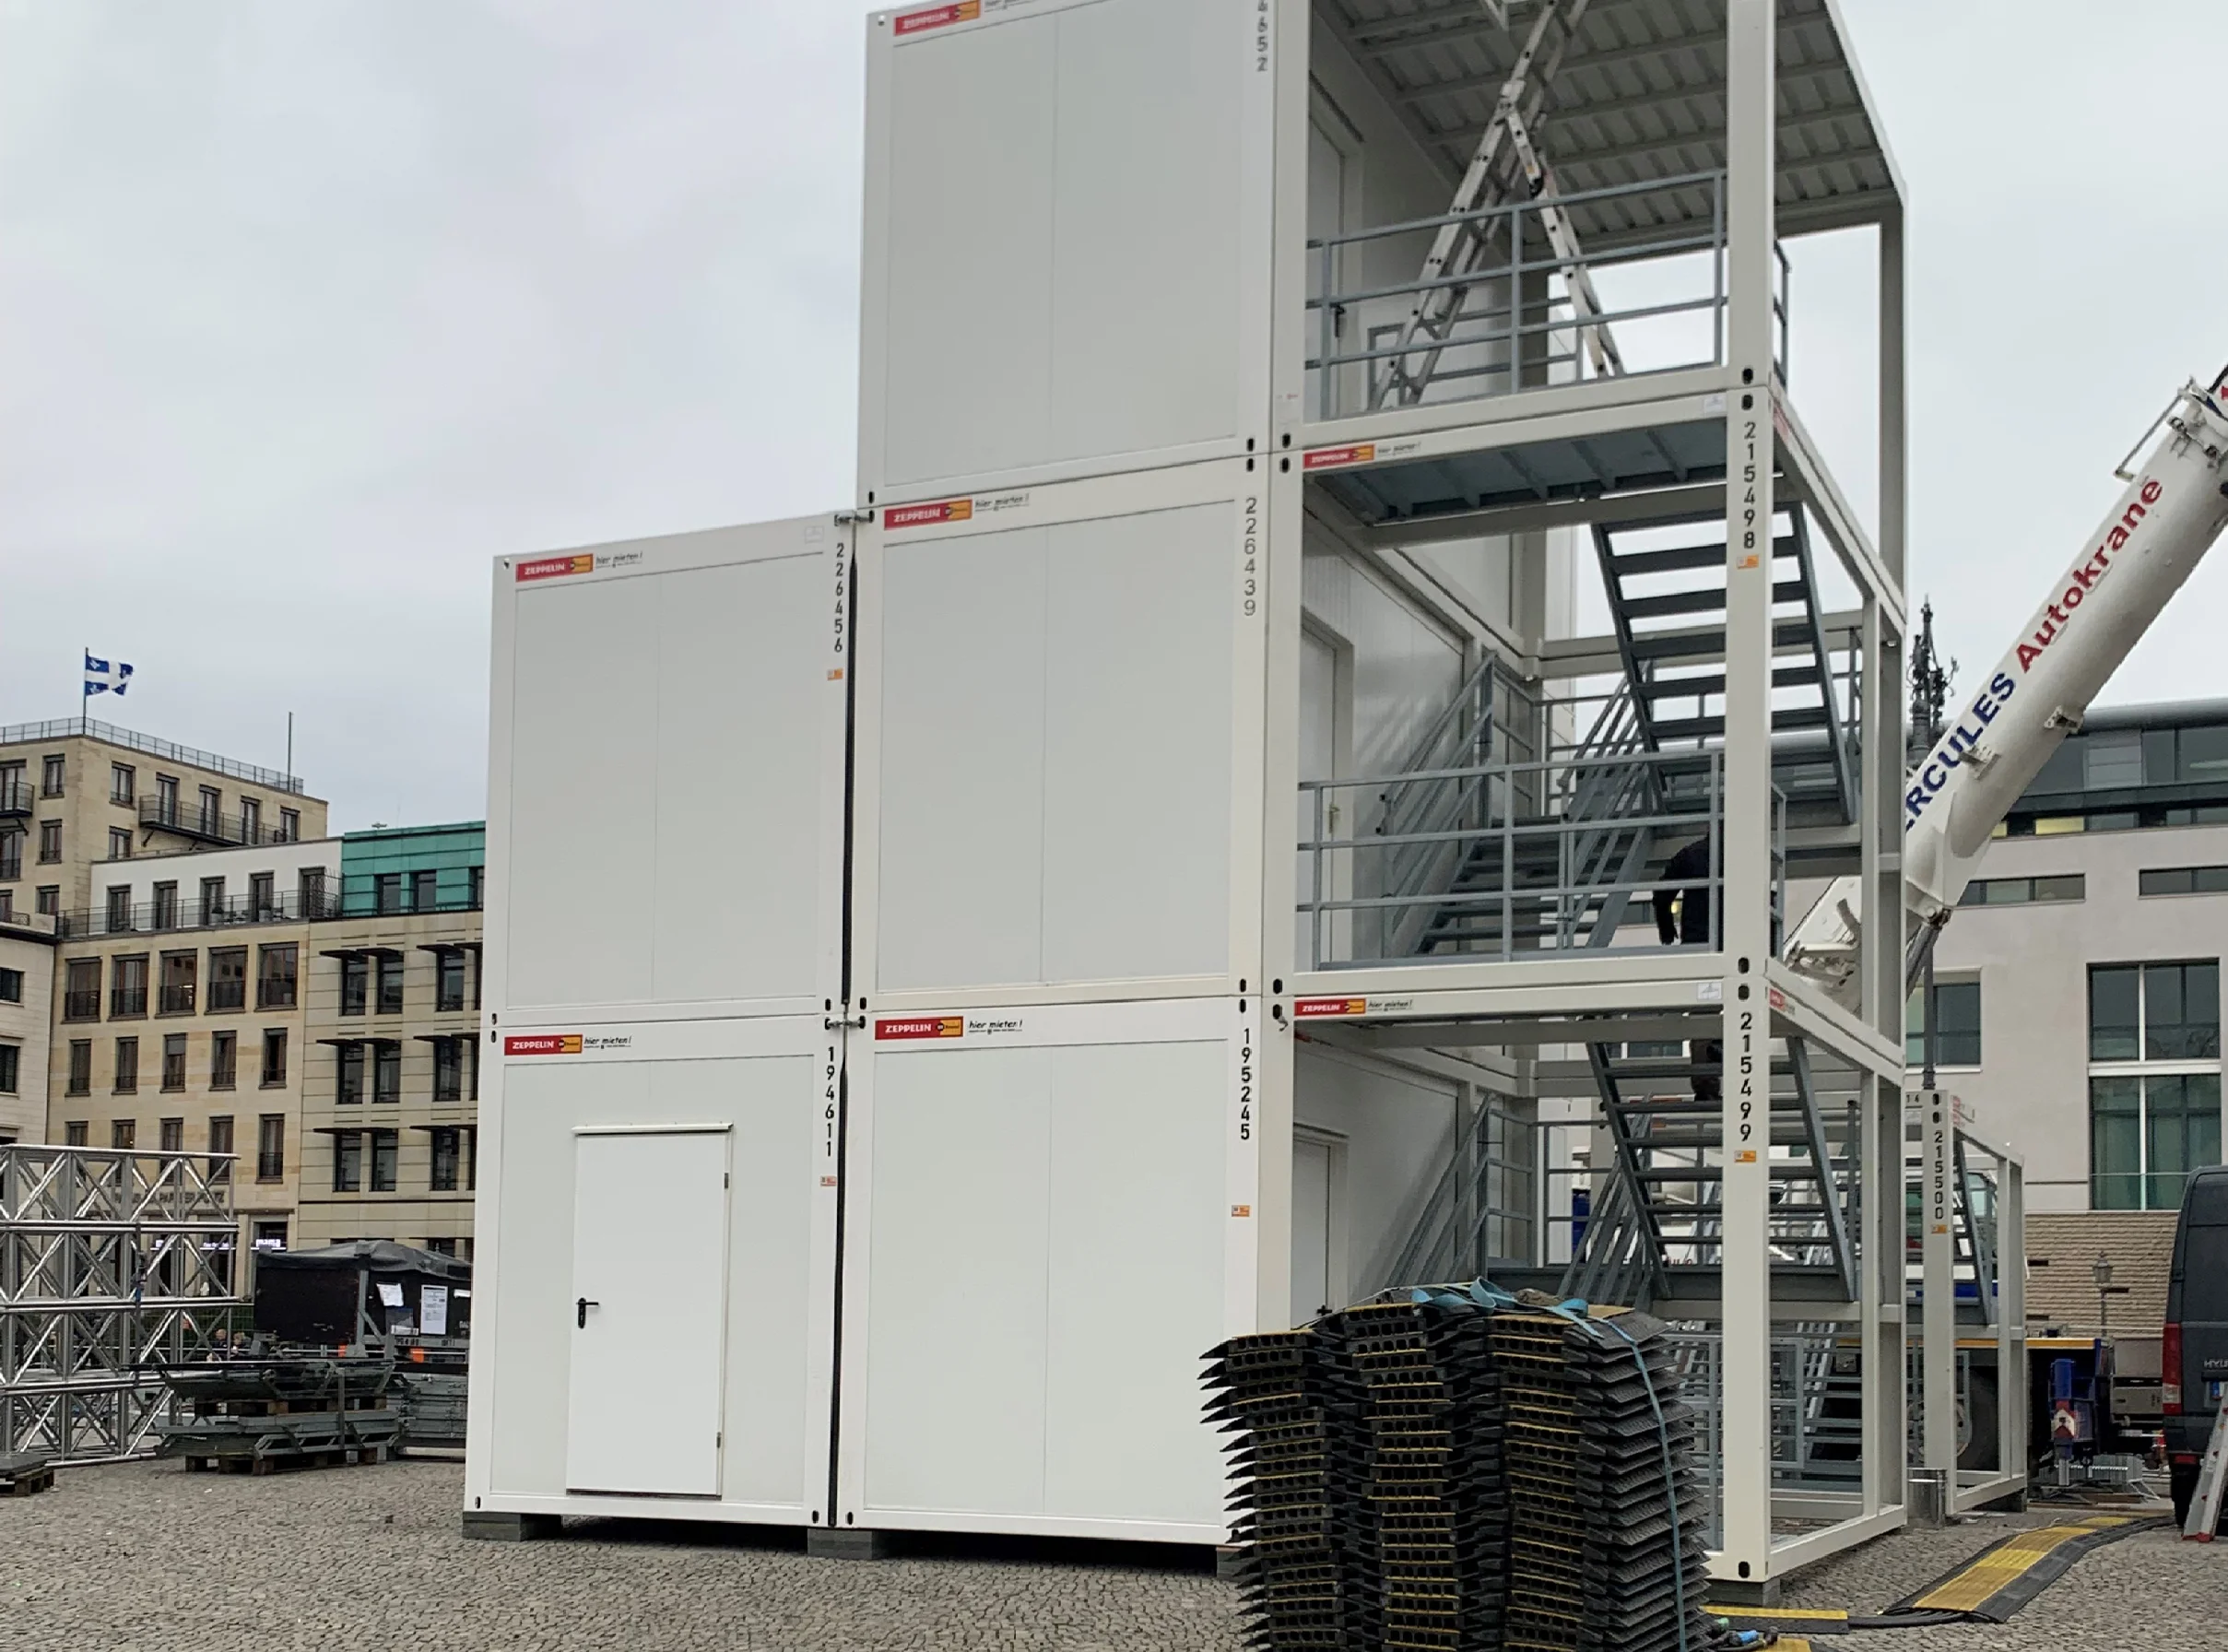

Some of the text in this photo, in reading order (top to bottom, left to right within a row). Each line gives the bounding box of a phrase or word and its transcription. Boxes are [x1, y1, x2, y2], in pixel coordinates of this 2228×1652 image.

[893, 508, 941, 523] ZEPPELIN
[1743, 421, 1756, 549] 215498
[525, 562, 565, 575] ZEPPELIN
[834, 542, 844, 653] 226456
[1244, 497, 1256, 617] 226439
[1905, 478, 2163, 832] RCULES Autokrane
[512, 1040, 555, 1050] ZEPPELIN
[885, 1023, 932, 1033] ZEPPELIN
[969, 1020, 986, 1029] hier
[1303, 1004, 1340, 1012] ZEPPELIN
[825, 1046, 835, 1157] 194611
[1240, 1028, 1253, 1140] 195245
[1739, 1012, 1752, 1142] 215499
[1934, 1130, 1944, 1220] 215500
